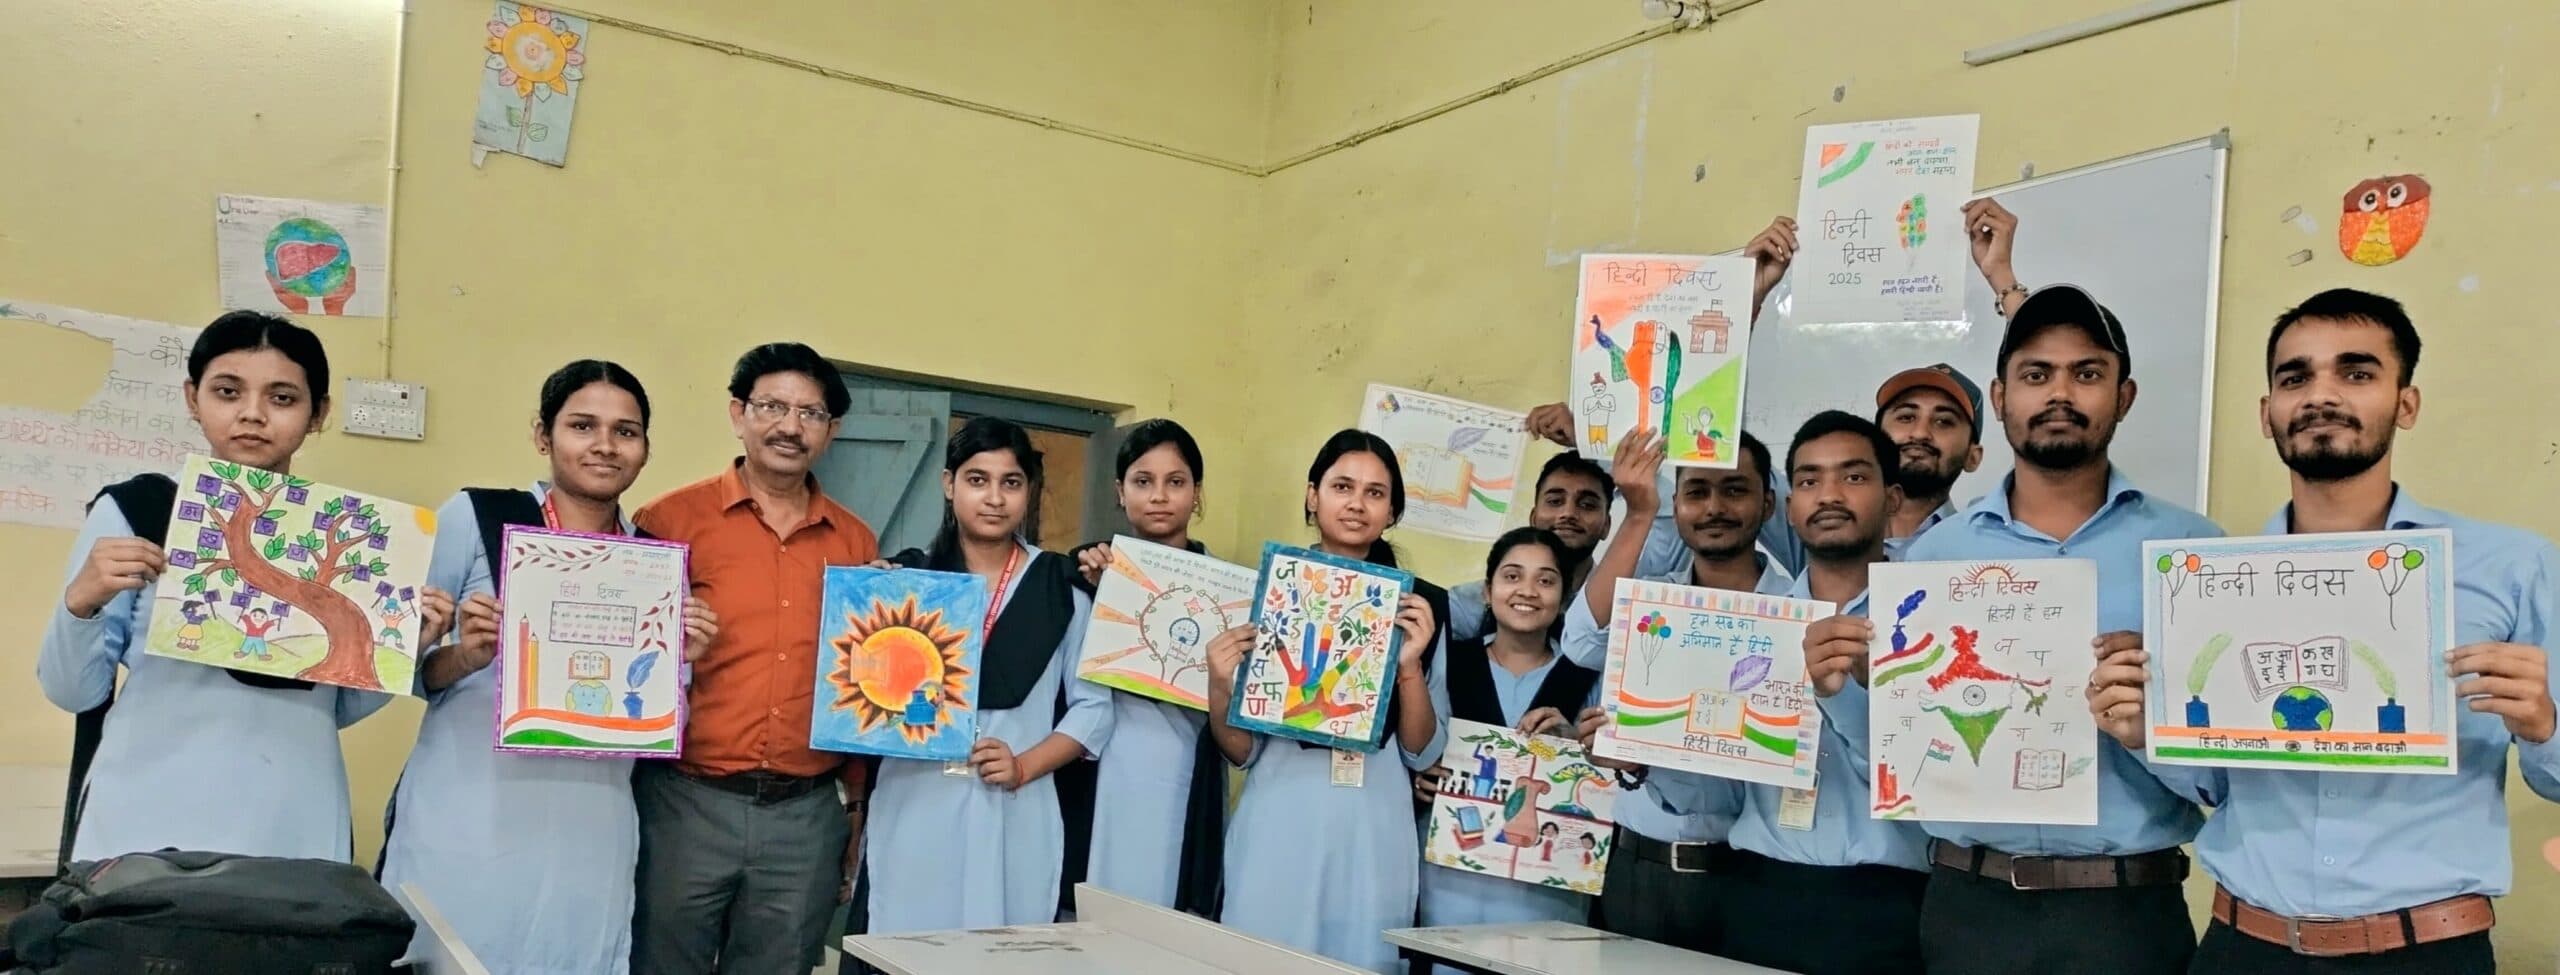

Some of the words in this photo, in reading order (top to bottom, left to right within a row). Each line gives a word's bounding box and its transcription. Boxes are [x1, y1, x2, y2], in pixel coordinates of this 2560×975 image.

[1828, 272, 1862, 285] 2025
[1276, 561, 1298, 580] ज
[2194, 561, 2259, 599] हिन्दी
[2275, 561, 2354, 597] दिवस
[1330, 574, 1359, 599] अ
[2026, 649, 2052, 667] प
[2257, 650, 2274, 666] अ
[2301, 647, 2318, 661] क
[2320, 645, 2335, 660] ख
[2304, 664, 2317, 678] ग
[1262, 682, 1283, 703] फ
